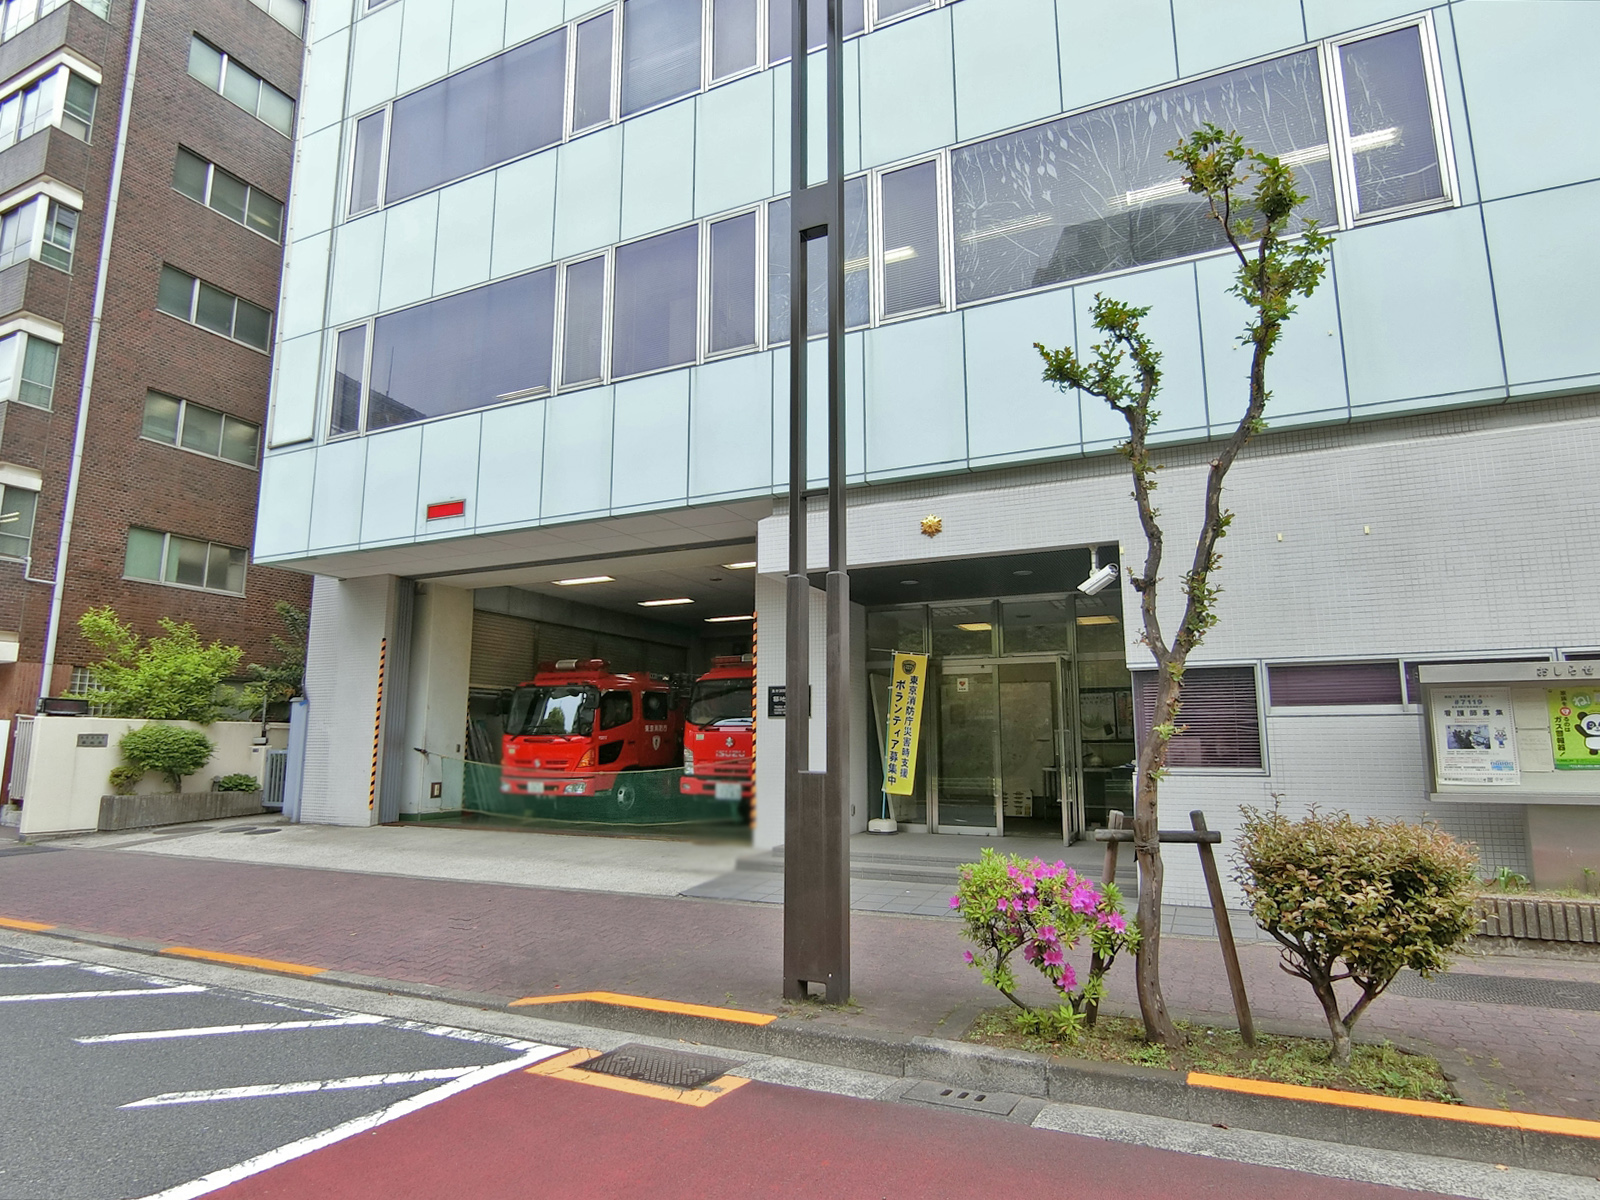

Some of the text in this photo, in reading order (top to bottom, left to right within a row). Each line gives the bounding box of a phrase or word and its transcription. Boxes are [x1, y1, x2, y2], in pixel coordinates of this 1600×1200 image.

[1536, 665, 1594, 677] おしらせ
[887, 679, 906, 786] ボランティア募集中
[899, 675, 919, 779] 東京消防庁災害時支援
[1444, 709, 1504, 717] 看護師募集
